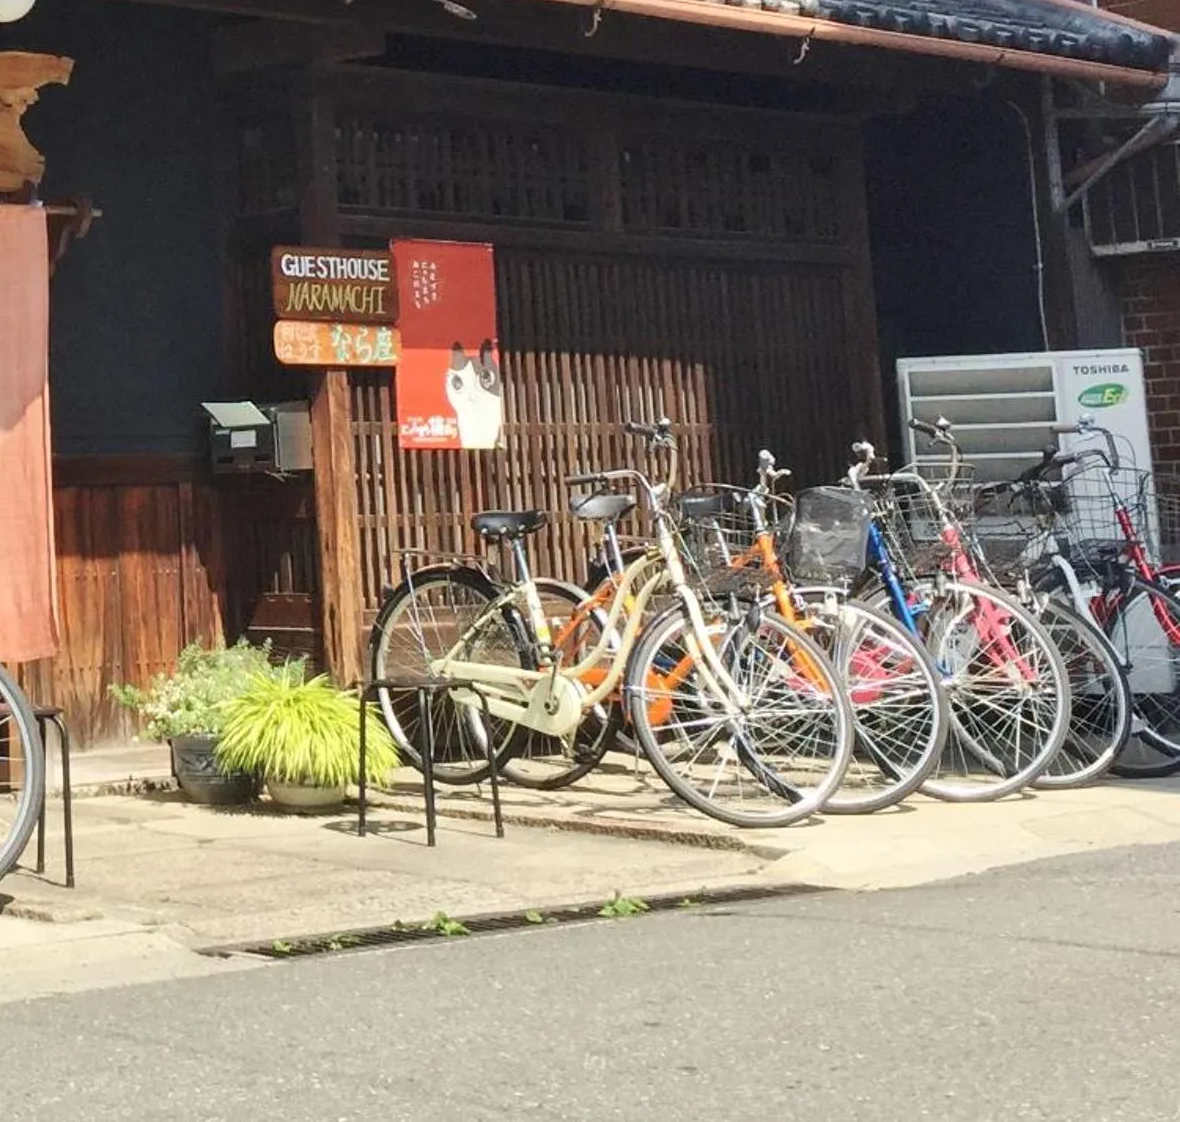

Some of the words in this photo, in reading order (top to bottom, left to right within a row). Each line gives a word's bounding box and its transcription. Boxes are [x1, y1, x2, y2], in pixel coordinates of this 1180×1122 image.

[281, 254, 391, 282] GUESTHOUSE
[285, 281, 387, 314] NARAMACHI
[1073, 364, 1129, 375] TOSHIBA
